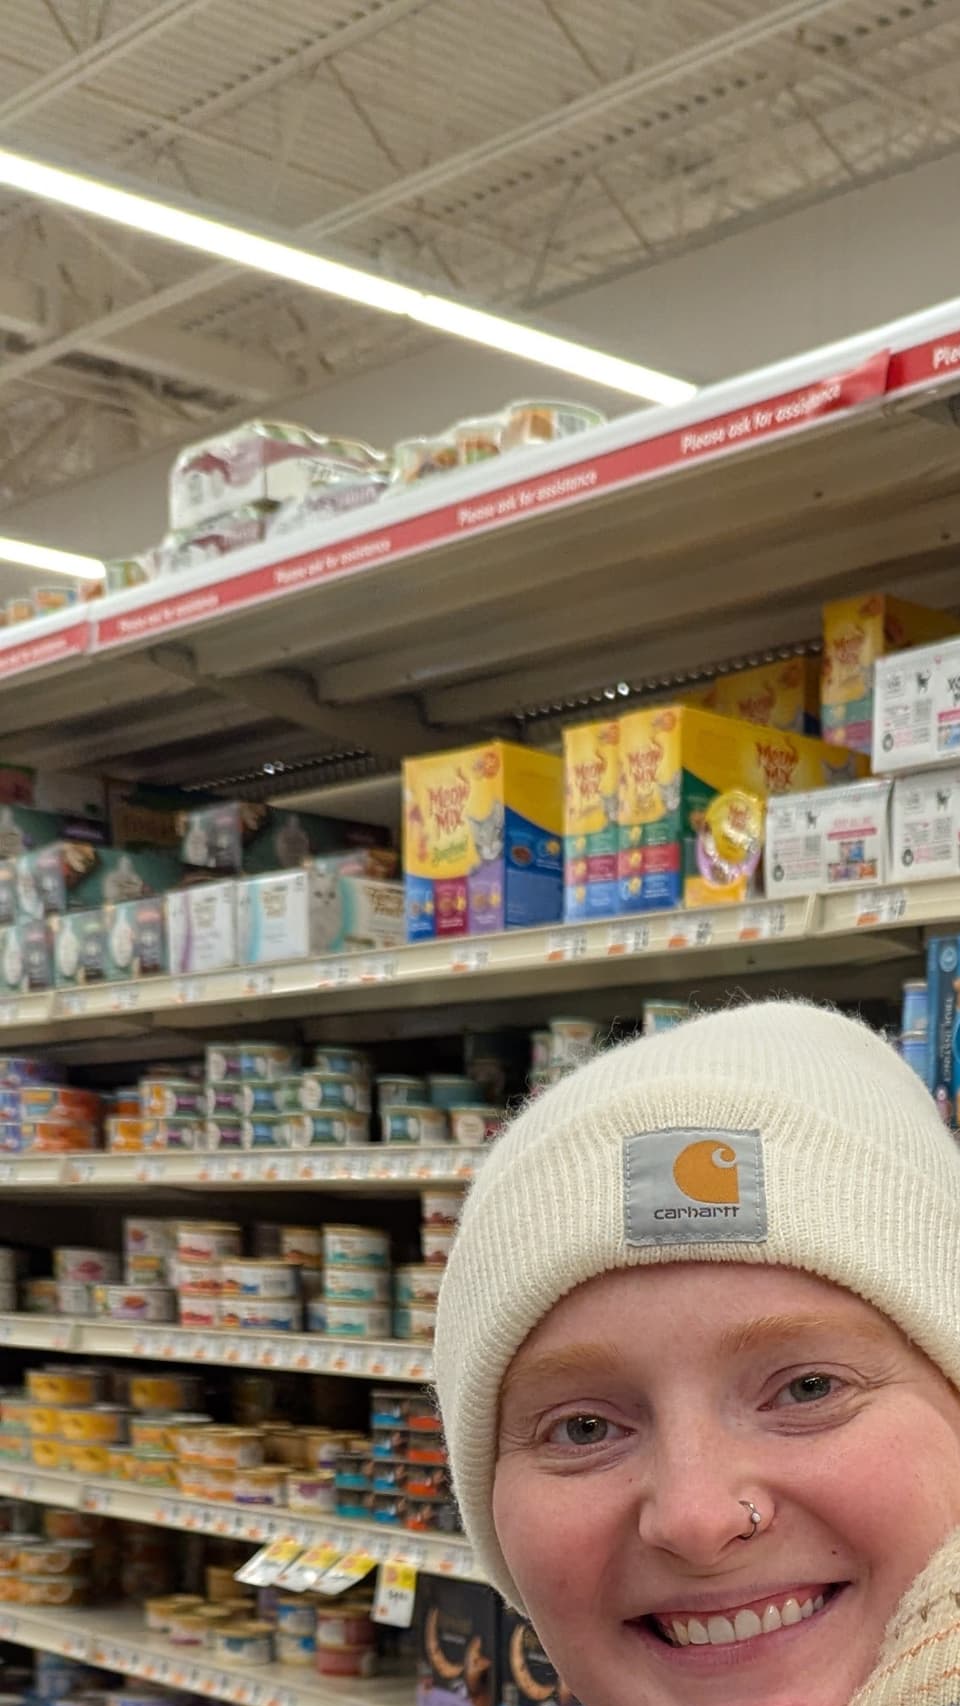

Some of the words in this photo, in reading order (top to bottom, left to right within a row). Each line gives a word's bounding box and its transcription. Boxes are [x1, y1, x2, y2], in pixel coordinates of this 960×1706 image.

[681, 429, 726, 454] Please
[728, 417, 751, 437] ask
[654, 1206, 740, 1220] carhartt
